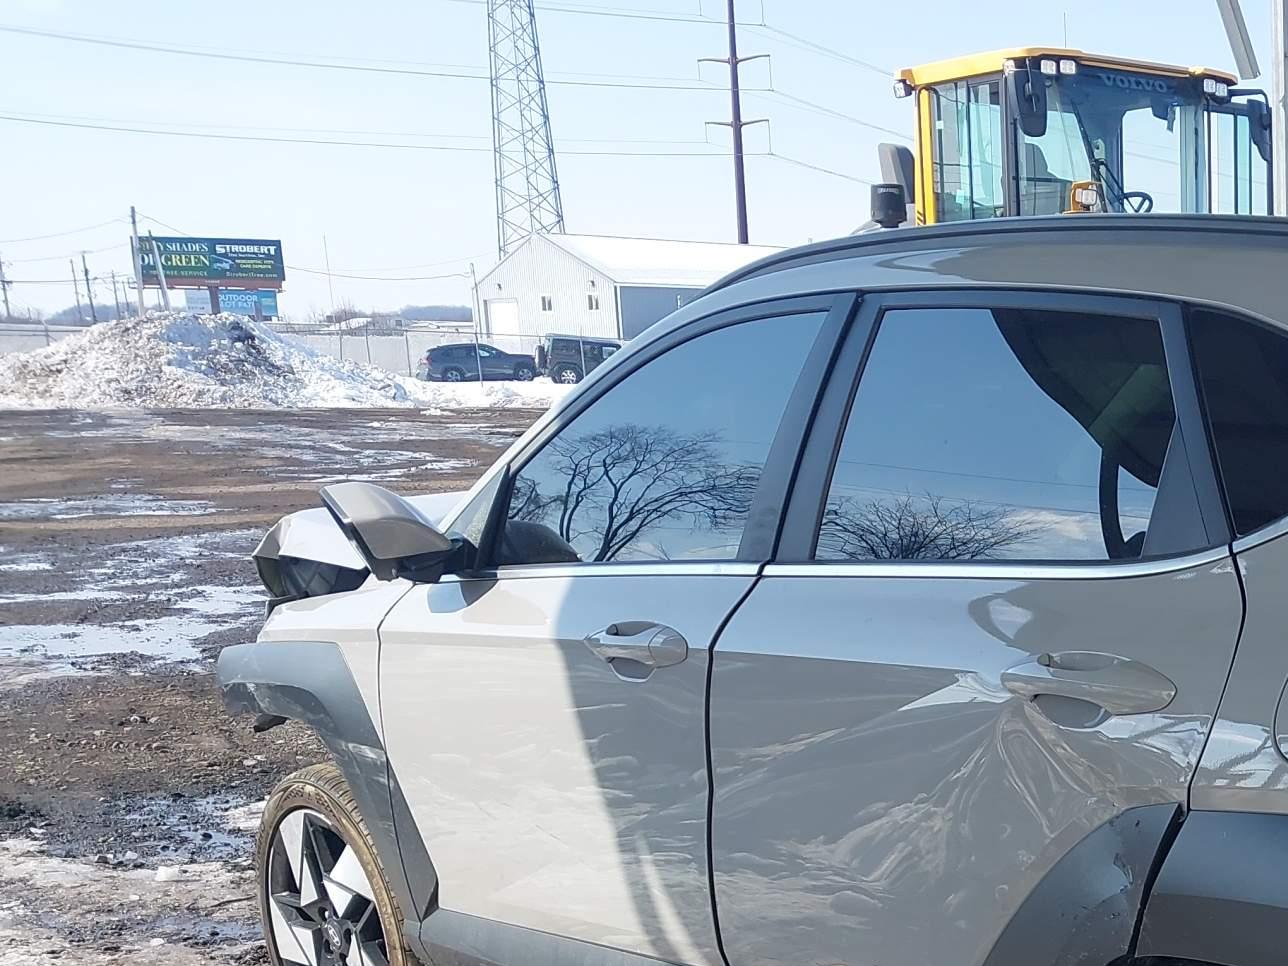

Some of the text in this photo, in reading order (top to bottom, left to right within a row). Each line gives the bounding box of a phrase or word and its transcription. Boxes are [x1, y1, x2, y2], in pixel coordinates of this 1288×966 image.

[1097, 74, 1168, 93] VOLVO
[166, 242, 209, 252] SHADES
[215, 244, 277, 256] STROBERT
[161, 253, 210, 267] GREEN
